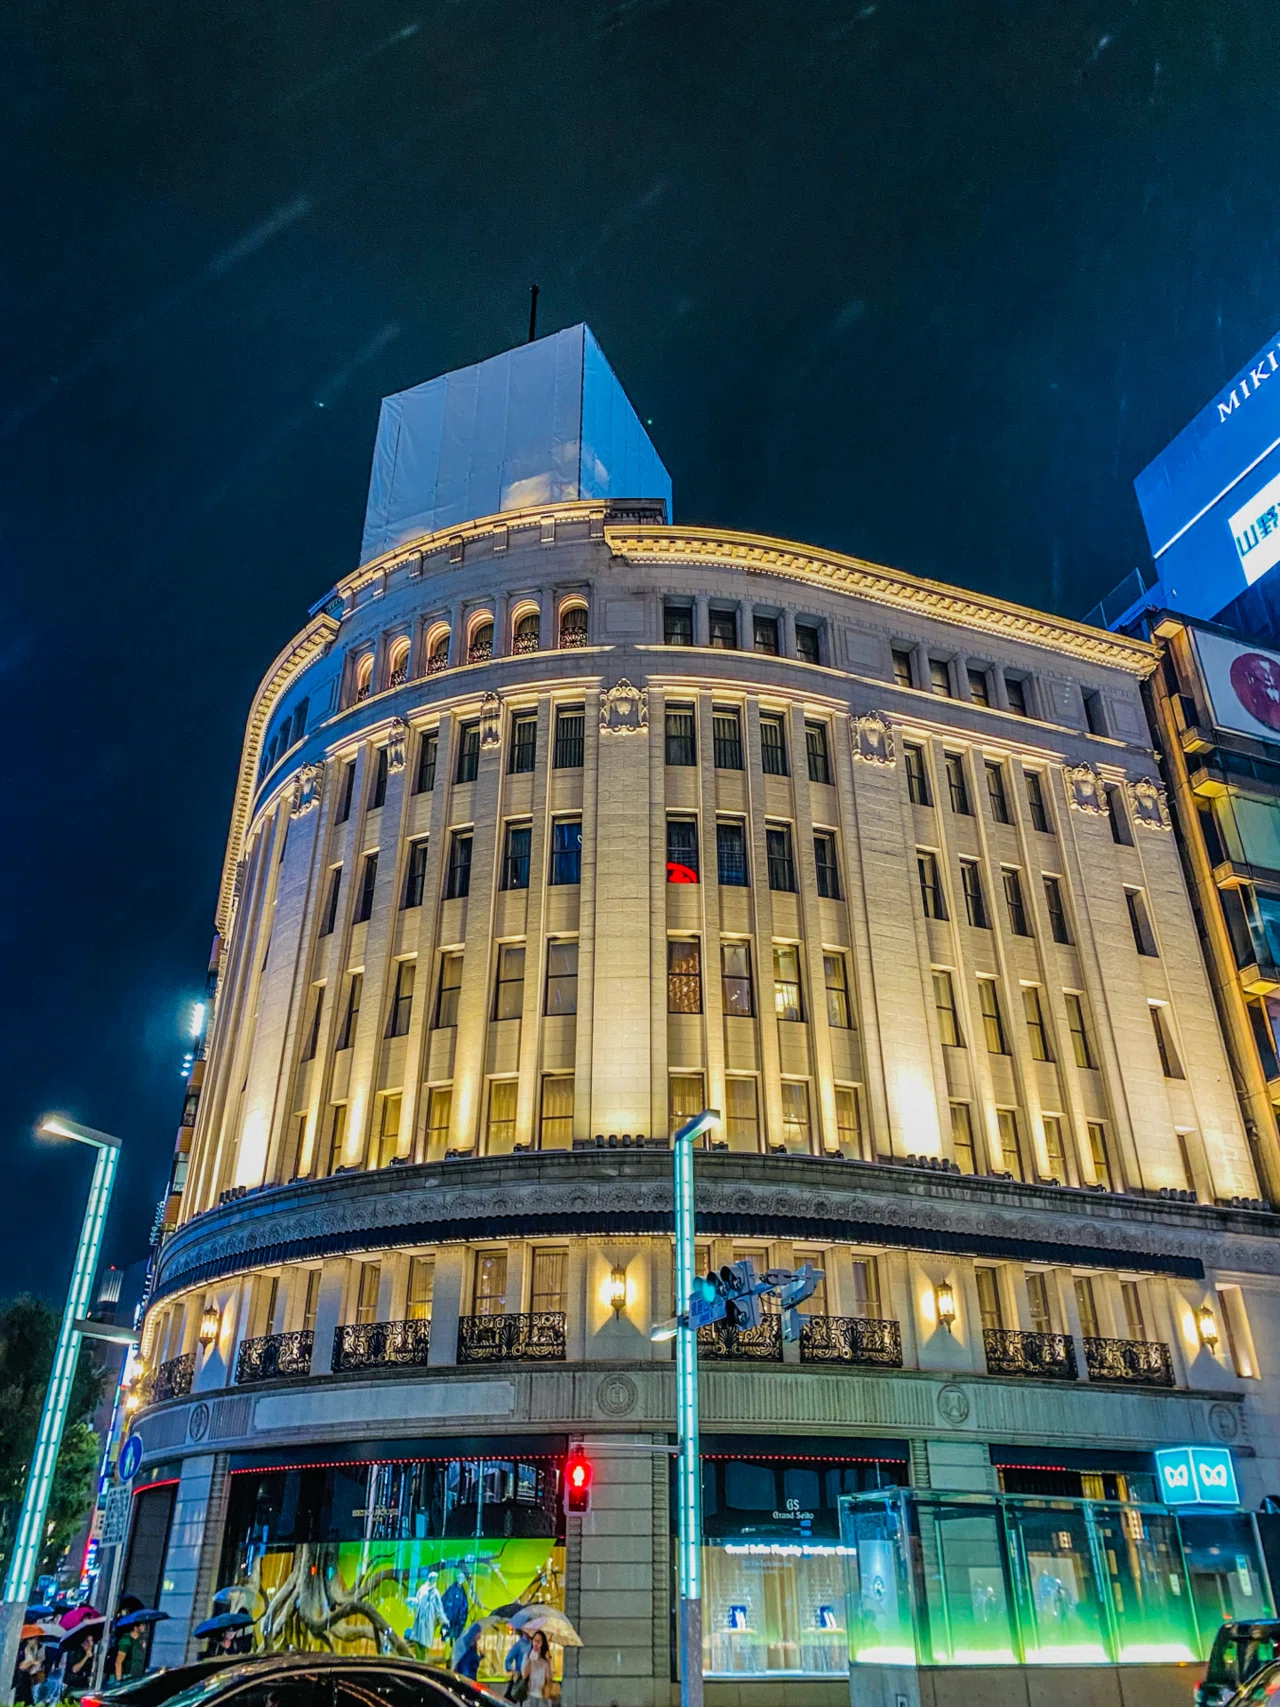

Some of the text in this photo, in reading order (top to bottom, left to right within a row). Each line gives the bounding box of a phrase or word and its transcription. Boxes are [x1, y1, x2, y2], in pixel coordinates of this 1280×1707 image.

[1217, 342, 1280, 423] MIKI
[1236, 502, 1280, 557] 山野
[772, 1510, 814, 1520] Grand Seiko
